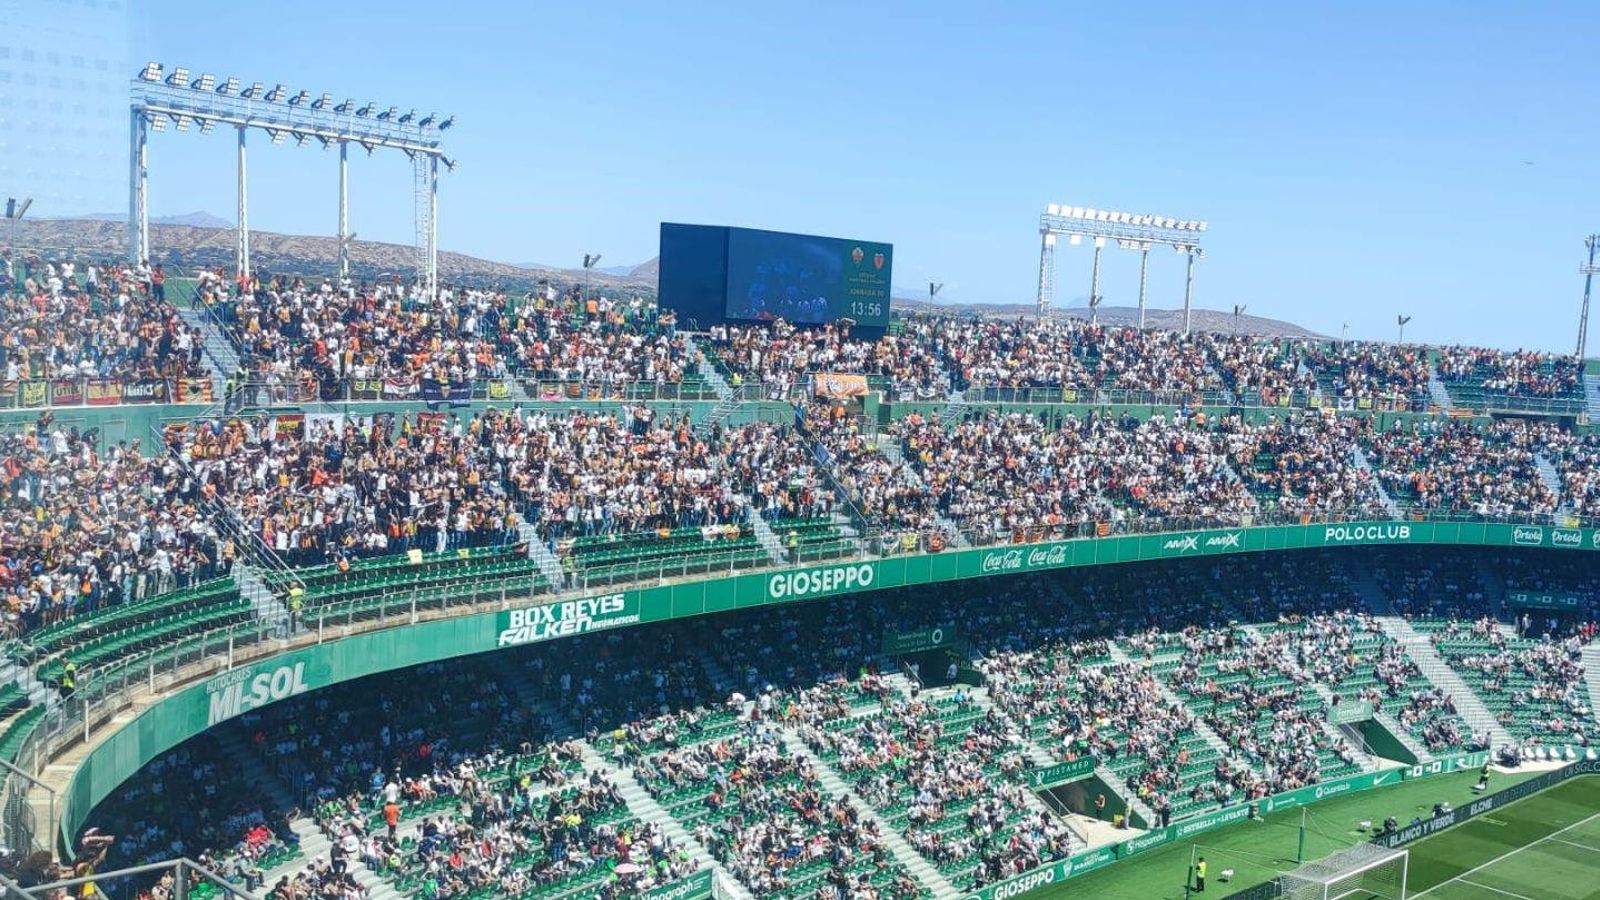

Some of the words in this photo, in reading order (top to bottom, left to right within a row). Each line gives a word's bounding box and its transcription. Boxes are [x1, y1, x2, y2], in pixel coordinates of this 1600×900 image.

[851, 301, 881, 317] 13:56
[769, 564, 874, 598] GIOSEPPO
[510, 604, 556, 628] BOX
[561, 594, 625, 621] REYES
[499, 616, 592, 646] FALKEN
[208, 662, 309, 728] MI-SOL
[1221, 808, 1249, 822] LEVANT
[1390, 828, 1421, 847] BLANCO
[1423, 823, 1429, 834] Y
[1430, 812, 1455, 832] VERDE
[995, 868, 1054, 900] GIOSEPPO
